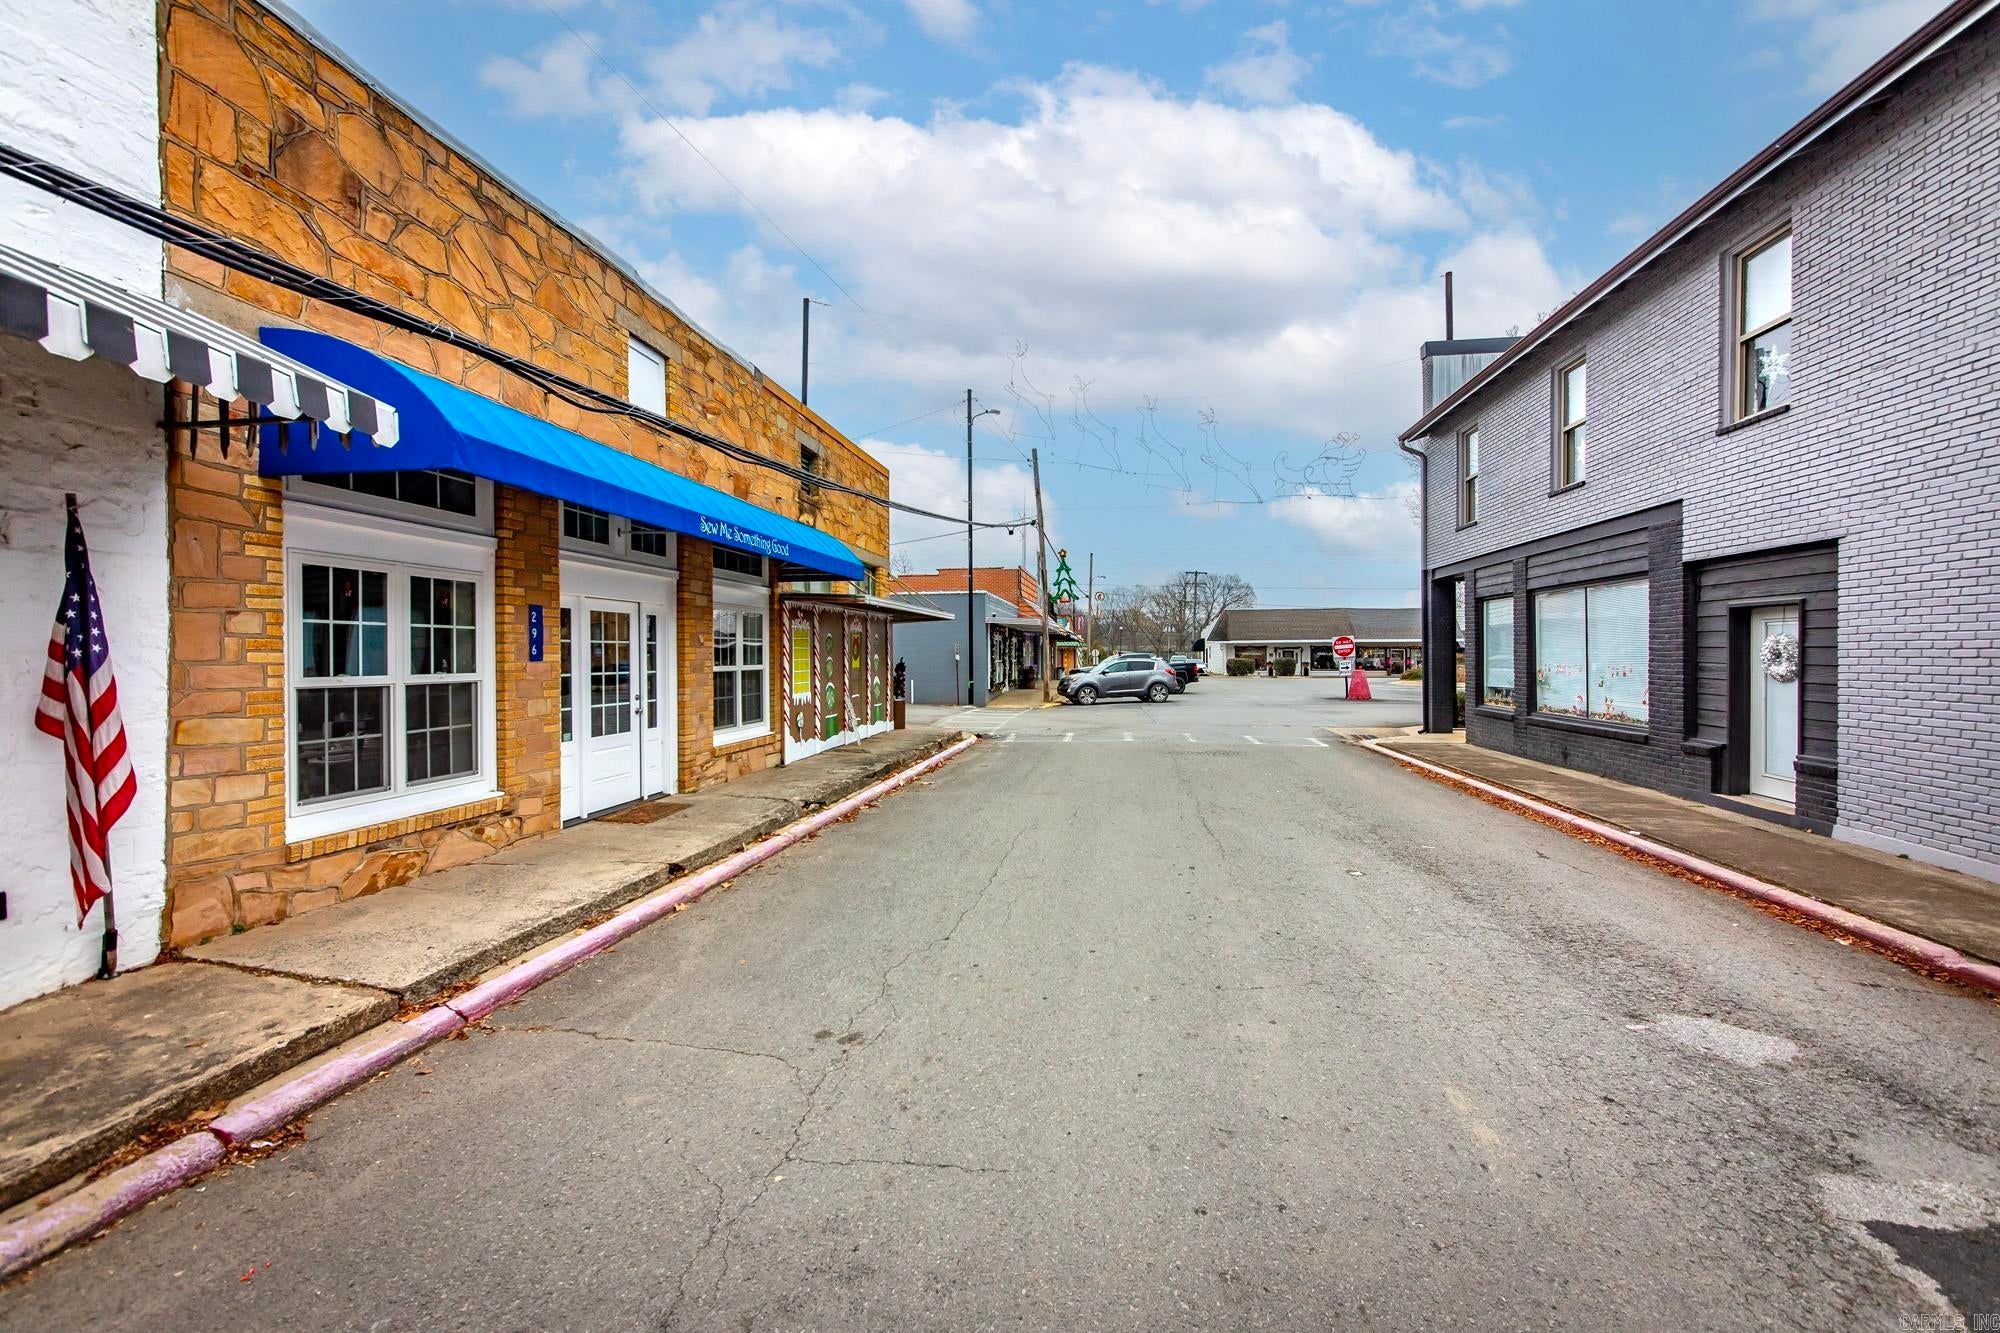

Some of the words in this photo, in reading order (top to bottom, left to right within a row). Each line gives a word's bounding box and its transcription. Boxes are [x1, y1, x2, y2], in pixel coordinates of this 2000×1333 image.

[700, 516, 719, 535] Sew
[719, 522, 733, 540] Me
[733, 527, 771, 554] Something
[772, 539, 789, 556] Good
